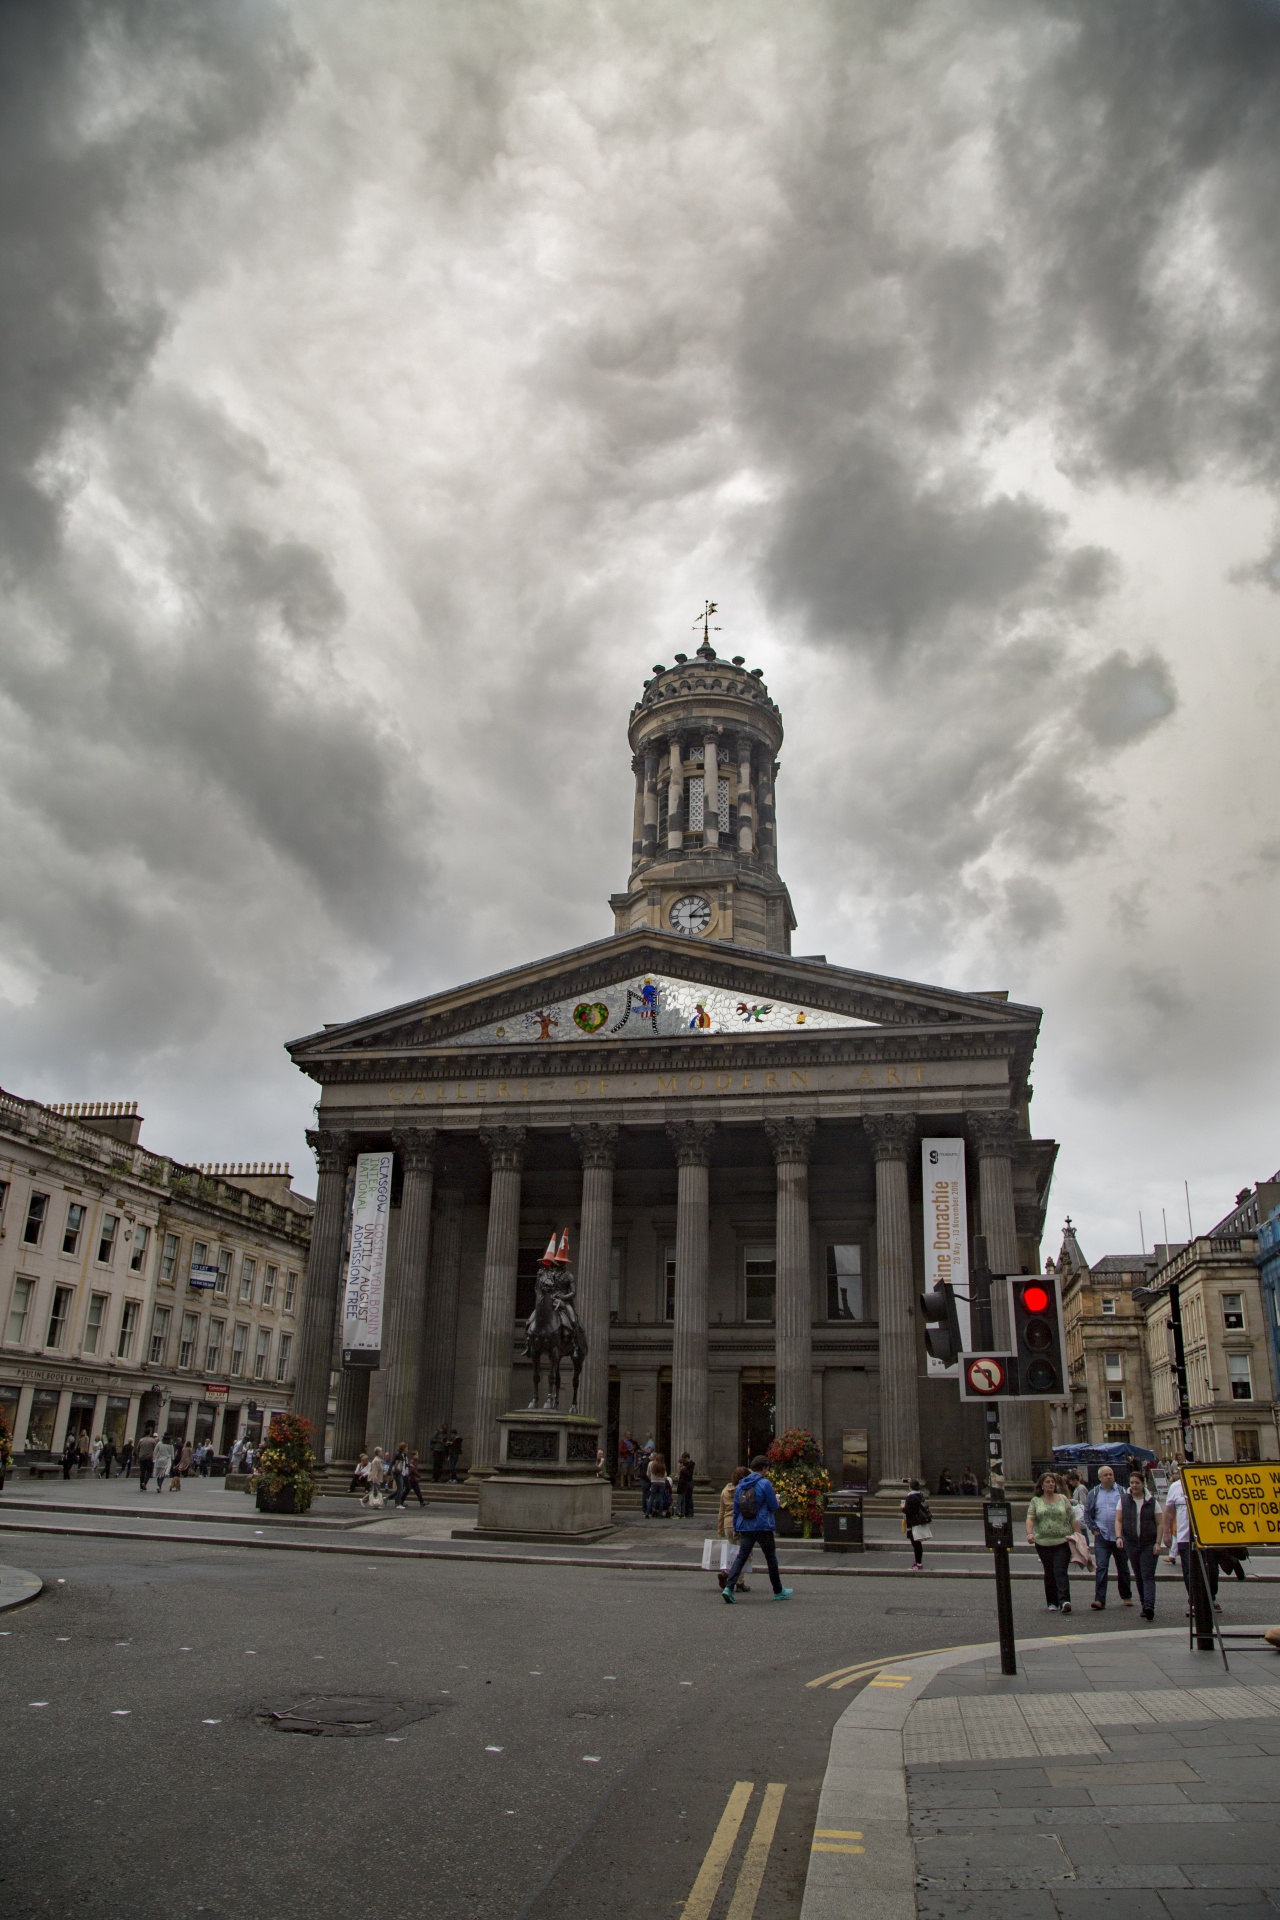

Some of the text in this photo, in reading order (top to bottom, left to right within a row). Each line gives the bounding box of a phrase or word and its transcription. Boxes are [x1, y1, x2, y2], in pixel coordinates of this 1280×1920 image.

[389, 1066, 926, 1101] GALLERY OF MODERN ART
[357, 1158, 369, 1215] NATIONAL
[368, 1158, 380, 1197] INTER-
[377, 1157, 390, 1213] GLASGOW
[931, 1181, 951, 1250] Donachie
[362, 1223, 374, 1261] UNTIL
[953, 1242, 961, 1256] May
[347, 1224, 363, 1319] ADMISSION FREE
[953, 1256, 961, 1265] 20
[368, 1223, 385, 1335] COSIMA VON BONIN
[358, 1276, 370, 1323] AUGUST
[17, 1369, 44, 1379] PAULINE
[46, 1372, 68, 1382] BOOKS
[76, 1376, 94, 1384] MEDIA
[1190, 1474, 1217, 1486] THIS
[1225, 1473, 1261, 1485] ROAD
[1192, 1489, 1208, 1500] BE
[1216, 1487, 1265, 1500] CLOSED
[1210, 1503, 1230, 1516] ON
[1219, 1521, 1245, 1533] FOR
[1253, 1521, 1260, 1532] 1
